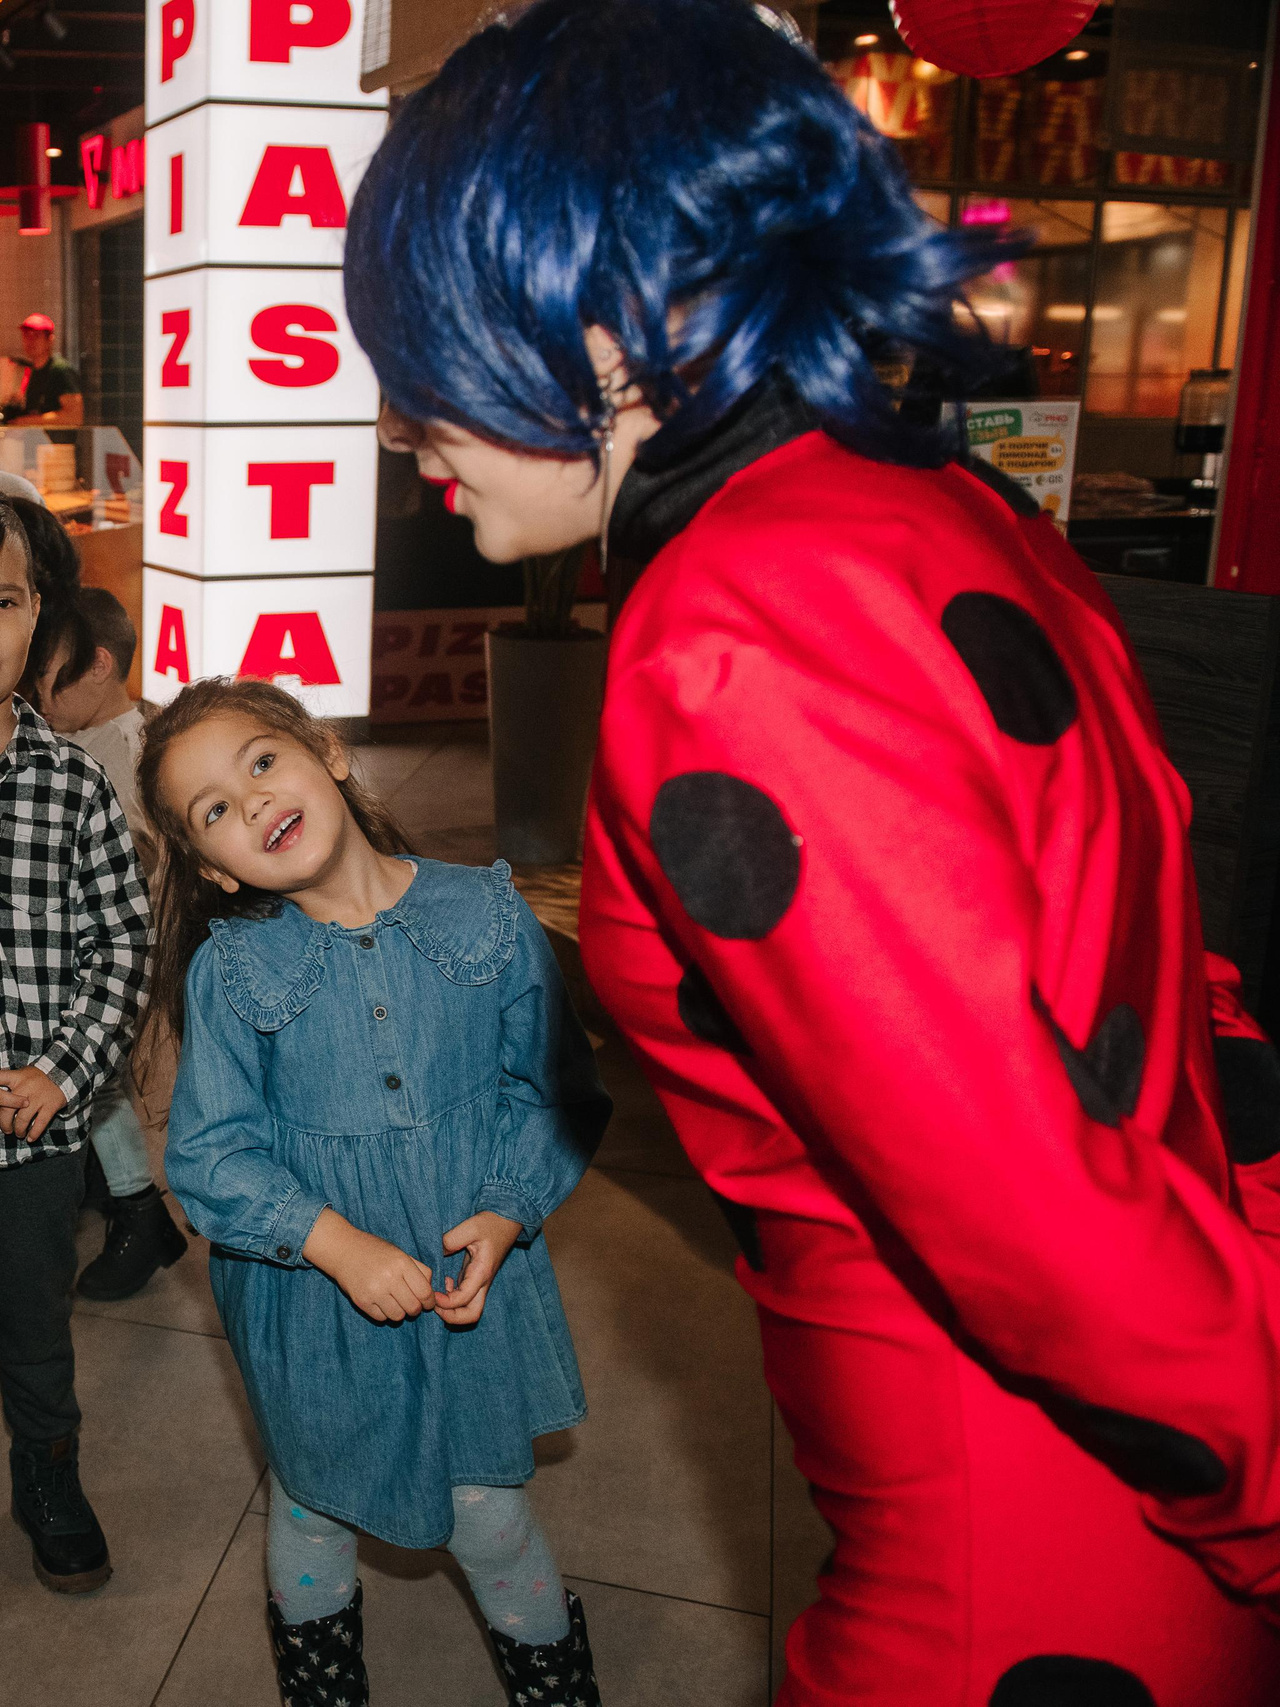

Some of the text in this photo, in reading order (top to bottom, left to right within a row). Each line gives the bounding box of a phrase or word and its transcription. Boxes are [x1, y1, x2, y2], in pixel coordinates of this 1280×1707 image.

[153, 0, 196, 685] PIZZA
[236, 0, 354, 686] PASTA
[966, 414, 1015, 430] СТАВЬ
[371, 670, 488, 708] PAS
